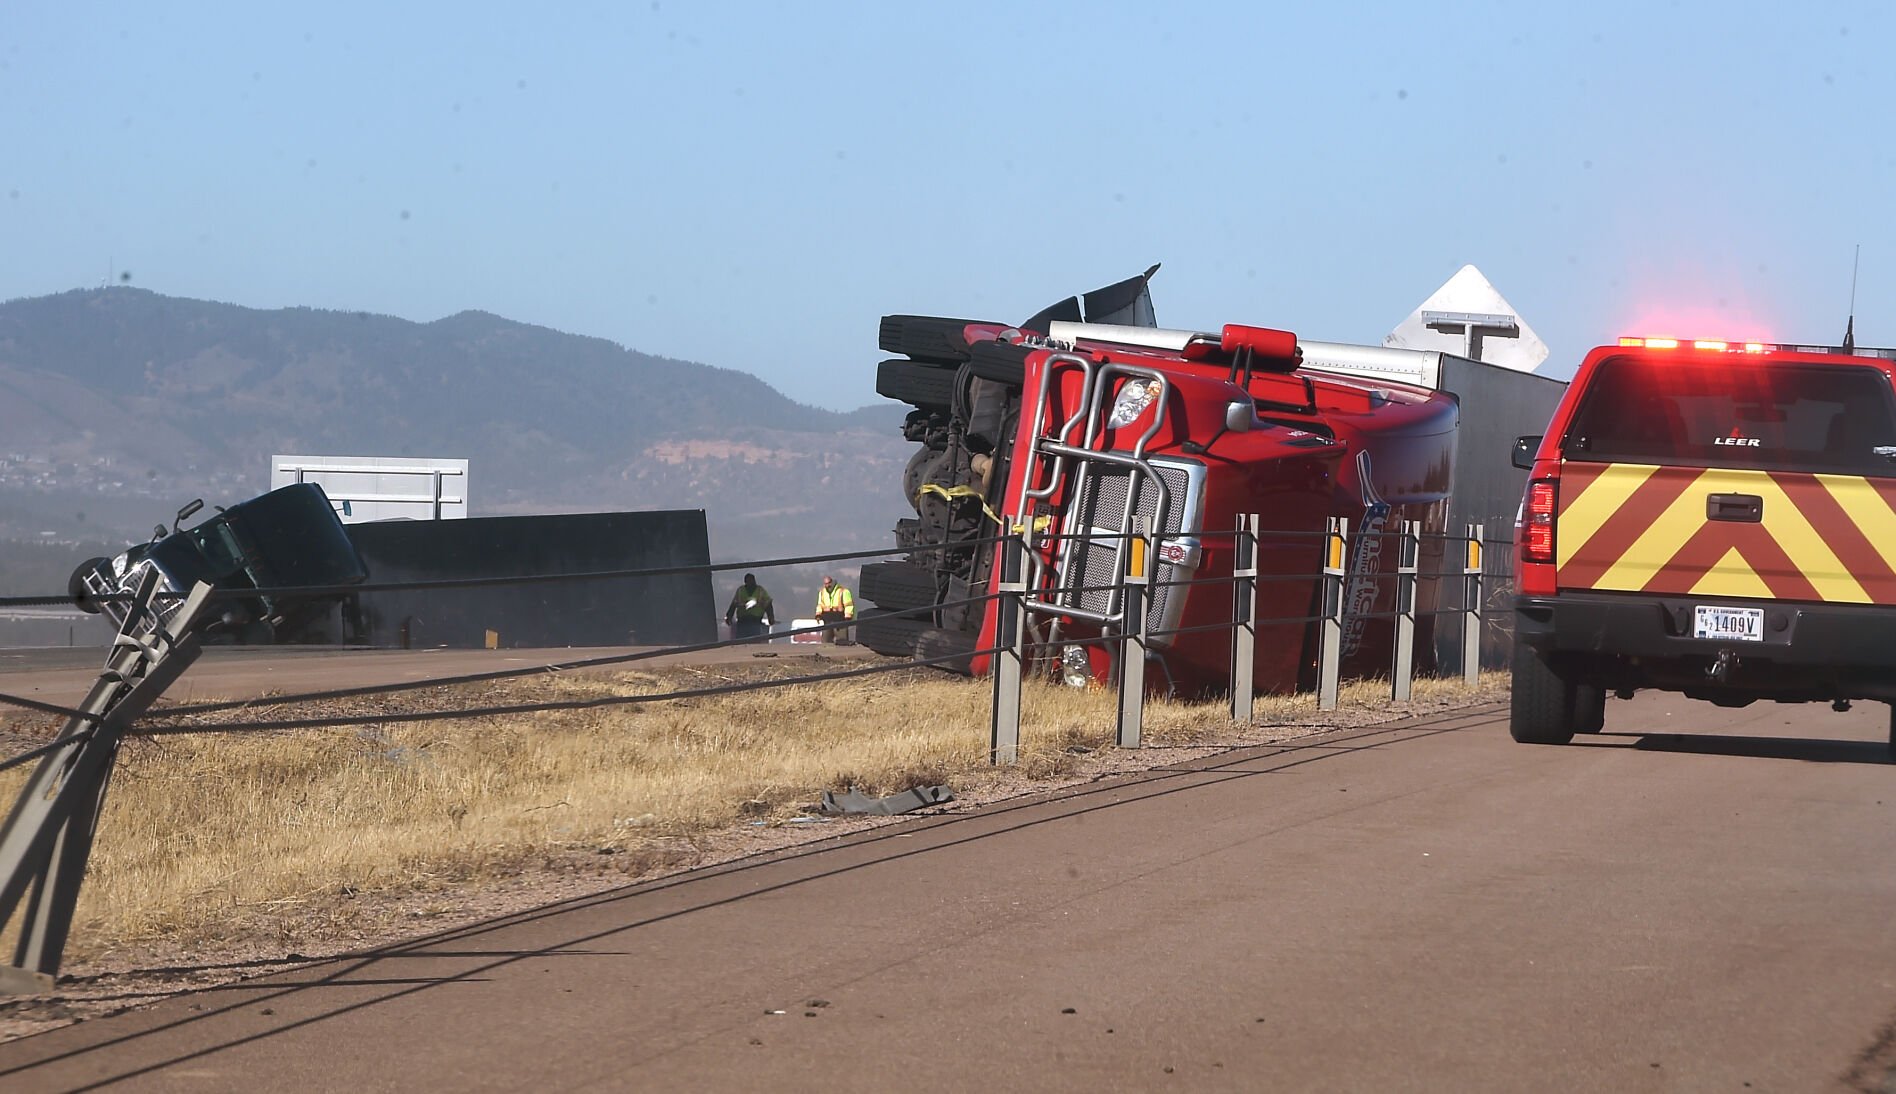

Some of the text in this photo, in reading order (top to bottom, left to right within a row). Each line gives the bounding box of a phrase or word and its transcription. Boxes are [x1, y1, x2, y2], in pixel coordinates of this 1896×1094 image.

[1714, 437, 1760, 447] LEER
[1359, 535, 1371, 585] Furnitue
[1715, 615, 1755, 634] 1409V
